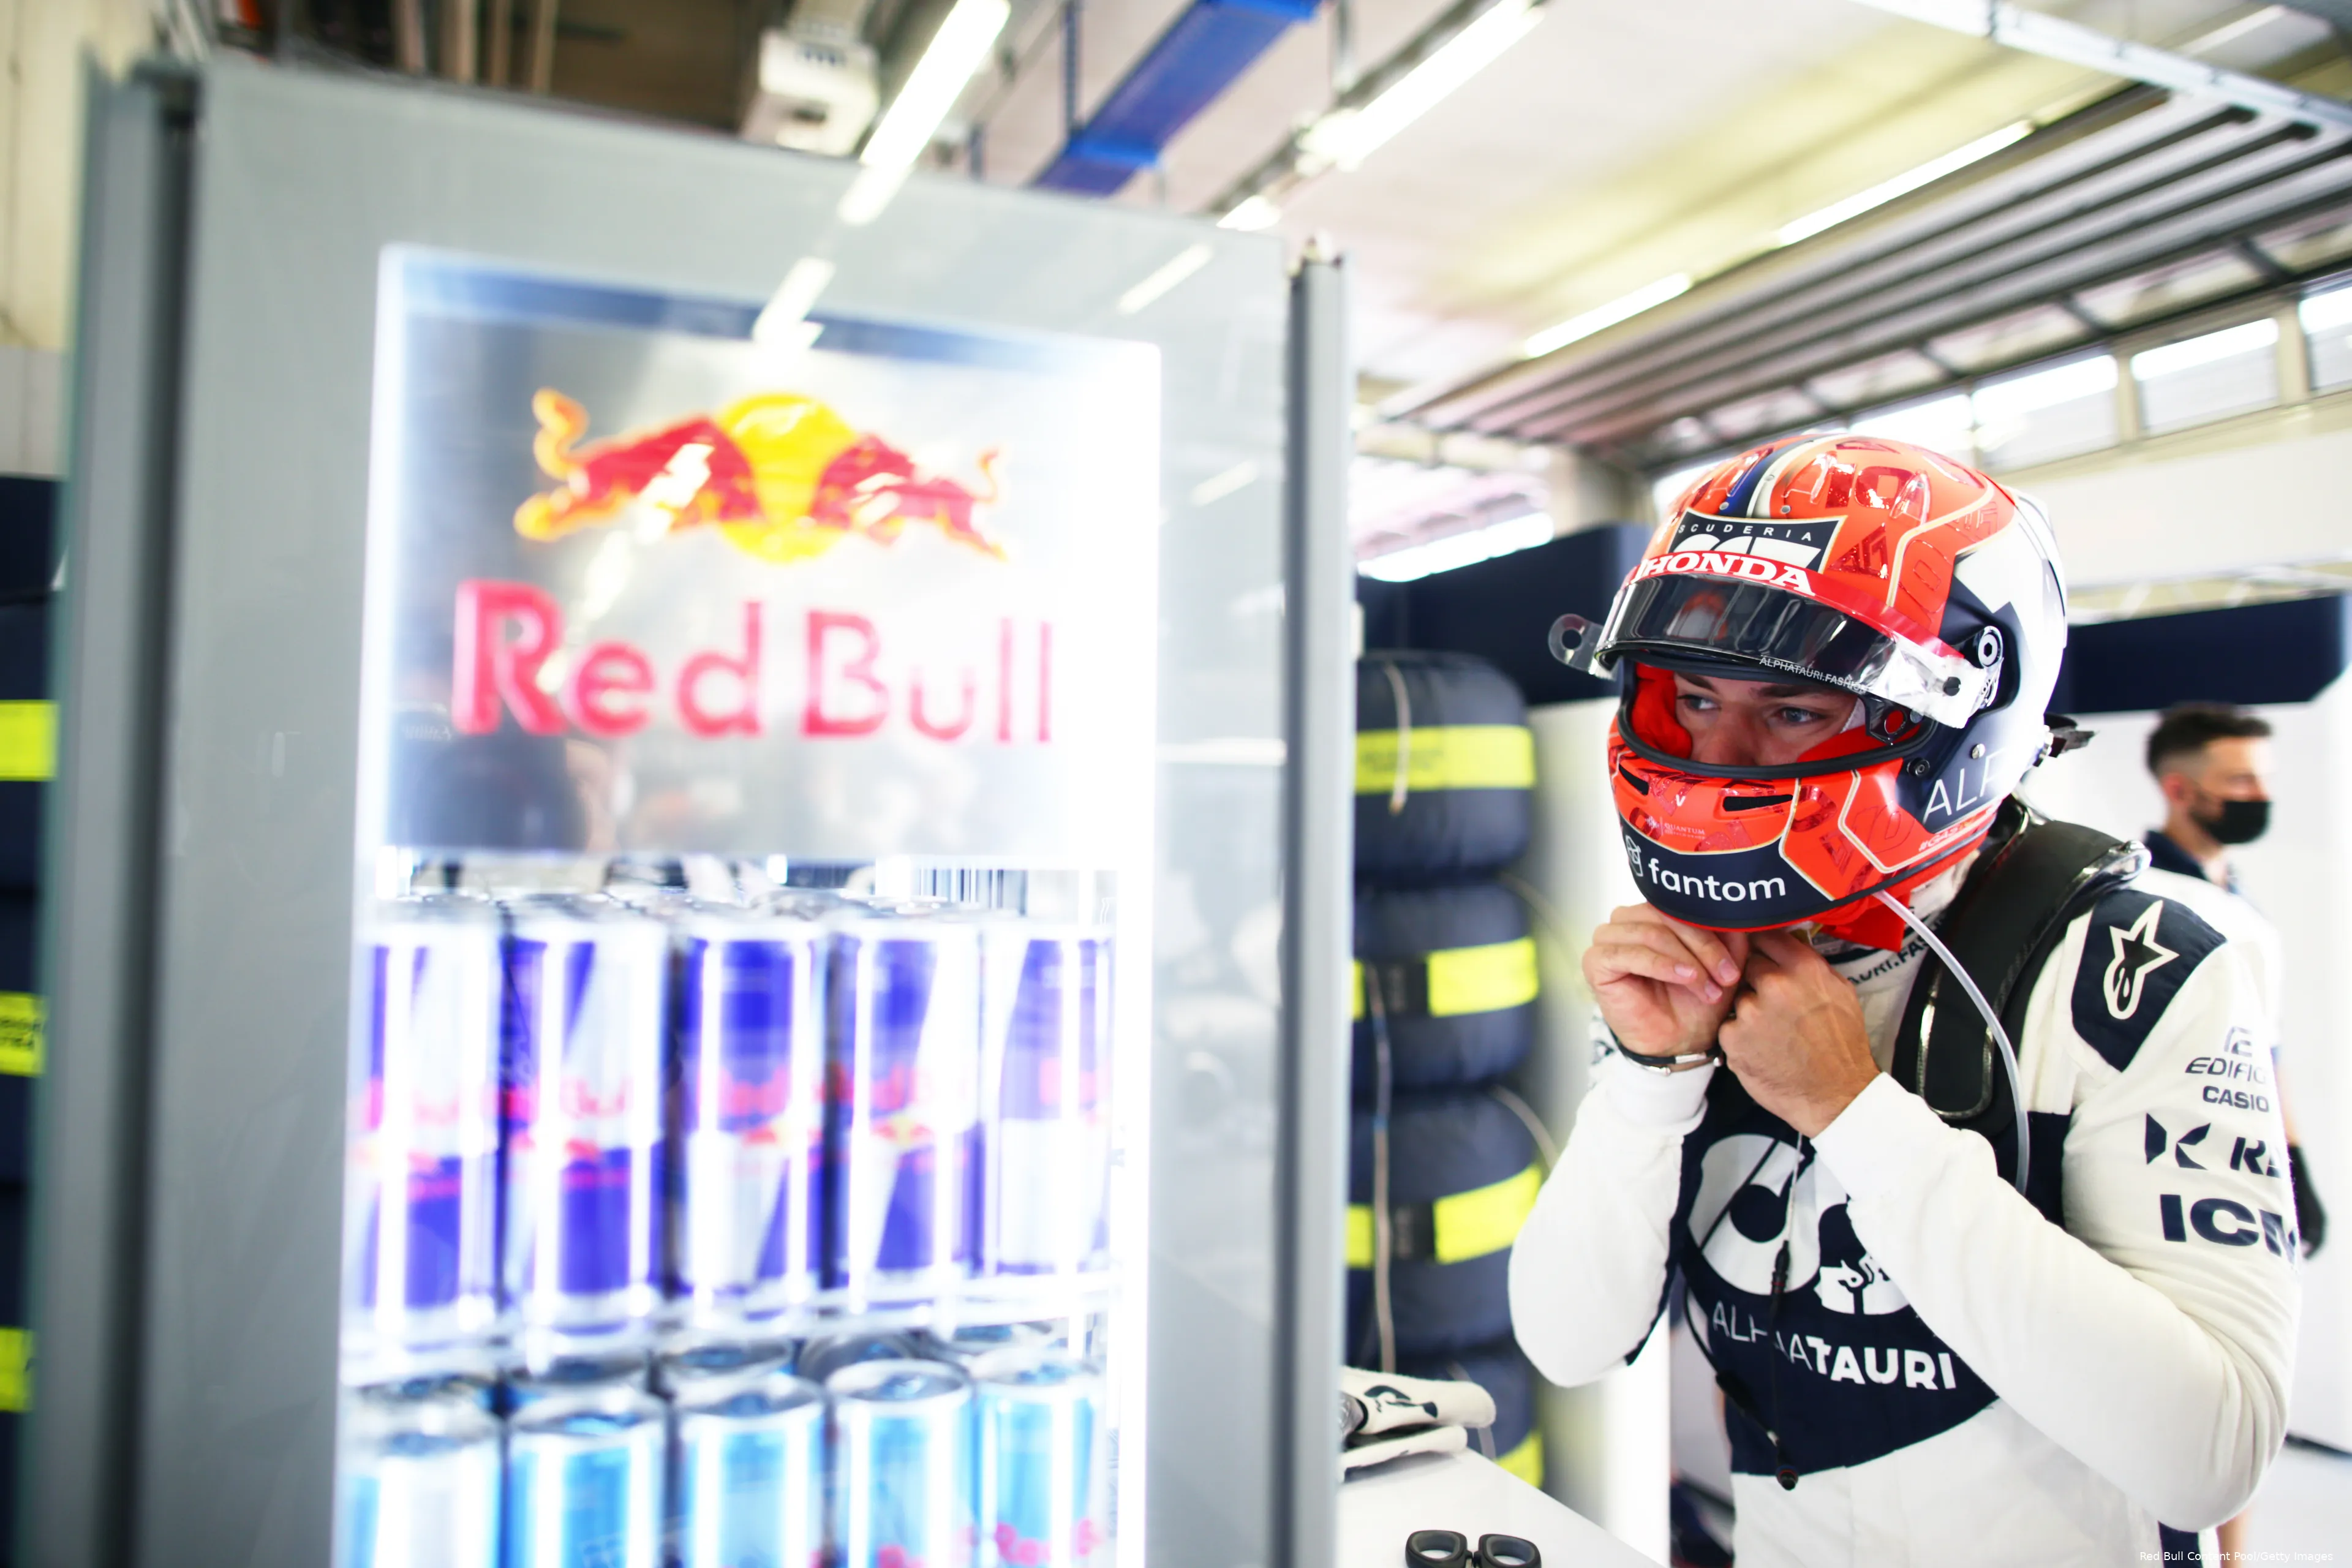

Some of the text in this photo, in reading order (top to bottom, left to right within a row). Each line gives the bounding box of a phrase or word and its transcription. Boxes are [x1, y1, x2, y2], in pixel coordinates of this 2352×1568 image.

[1678, 523, 1812, 542] SCUDERIA
[1635, 551, 1816, 597] HONDA
[452, 579, 1055, 744] Red Bull
[1923, 748, 2011, 824] ALP
[1664, 822, 1706, 835] QUANTUM
[1648, 858, 1786, 902] fantom
[2185, 1057, 2266, 1084] EDIFIC
[2203, 1085, 2270, 1113] CASIO
